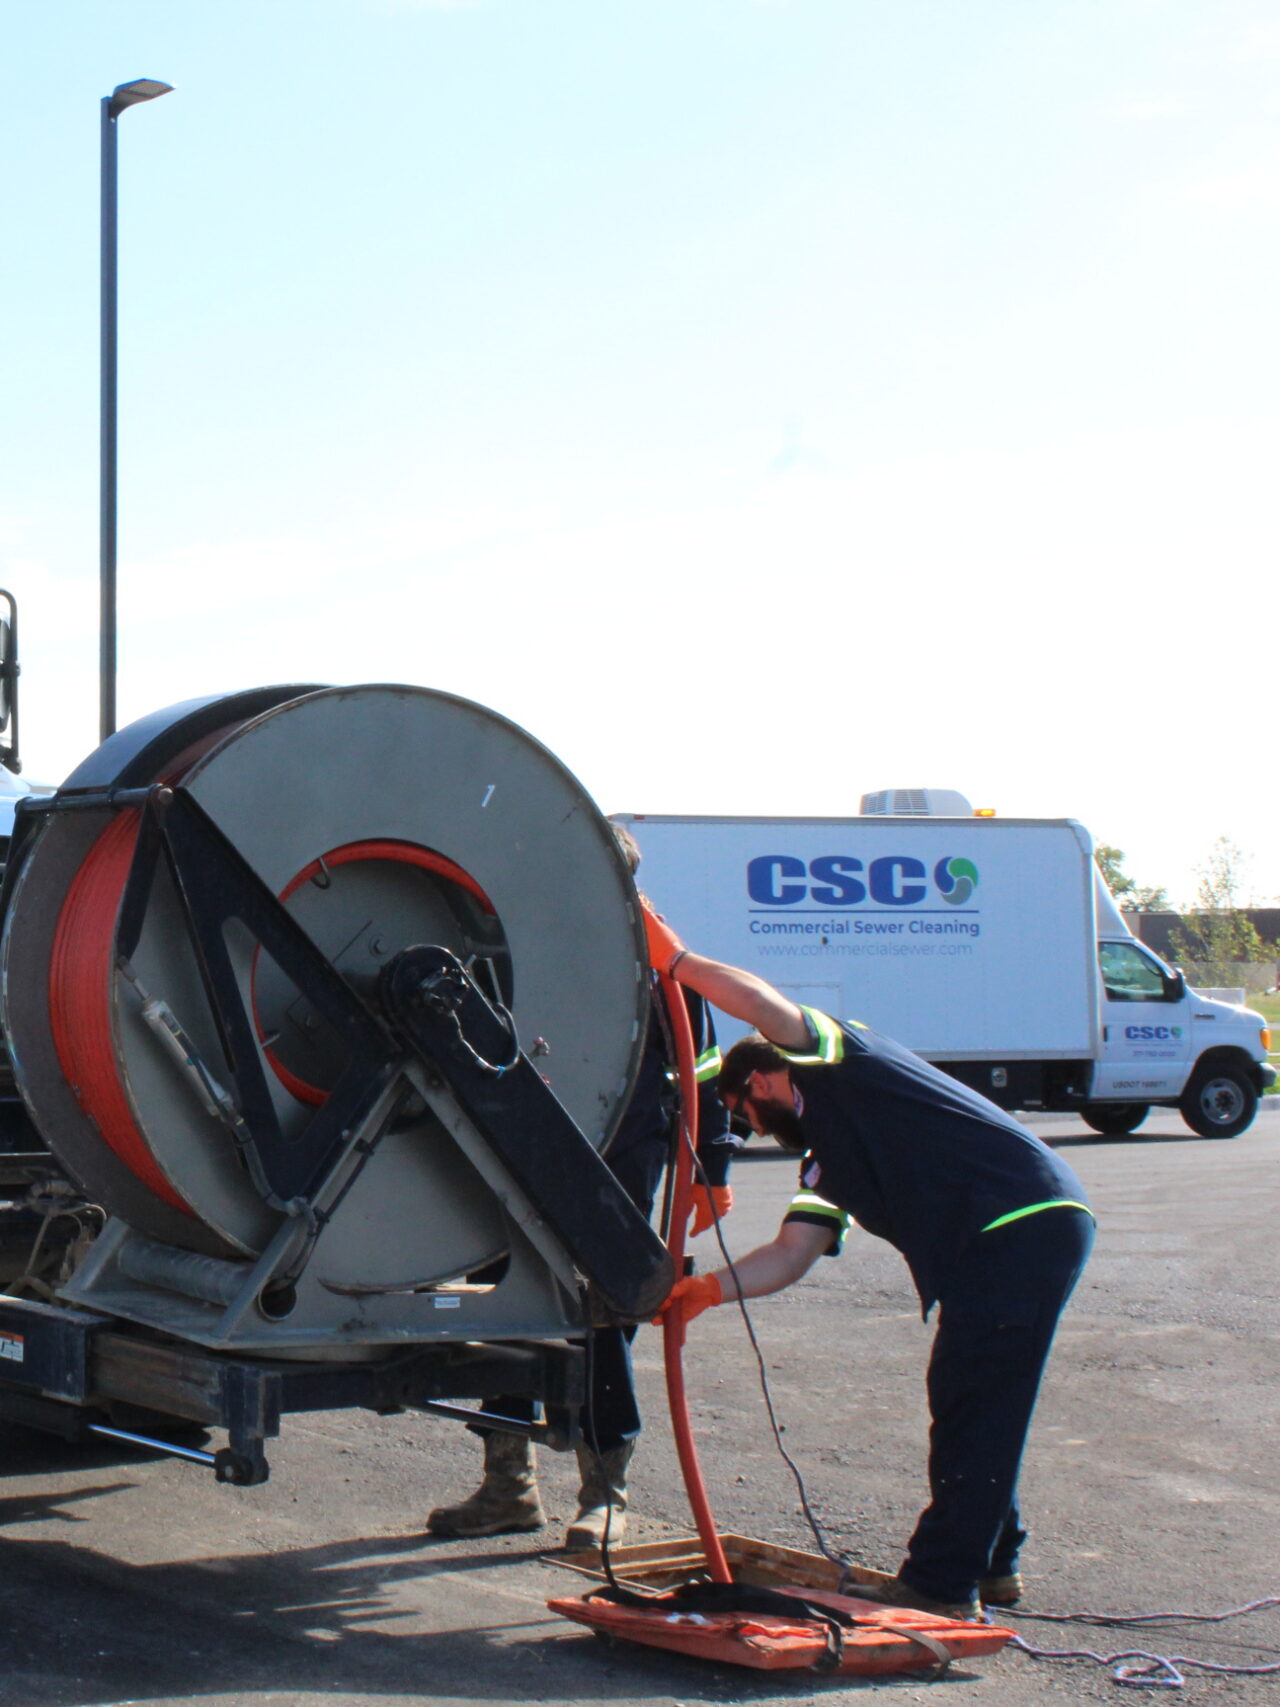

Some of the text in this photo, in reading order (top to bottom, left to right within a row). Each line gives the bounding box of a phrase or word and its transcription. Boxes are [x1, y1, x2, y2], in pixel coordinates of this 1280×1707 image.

[481, 784, 495, 808] 1
[747, 855, 926, 905] CSC
[749, 920, 980, 937] Commercial Sewer Cleaning
[757, 941, 973, 956] www.commercialsewer.com
[1125, 1026, 1169, 1039] CSC
